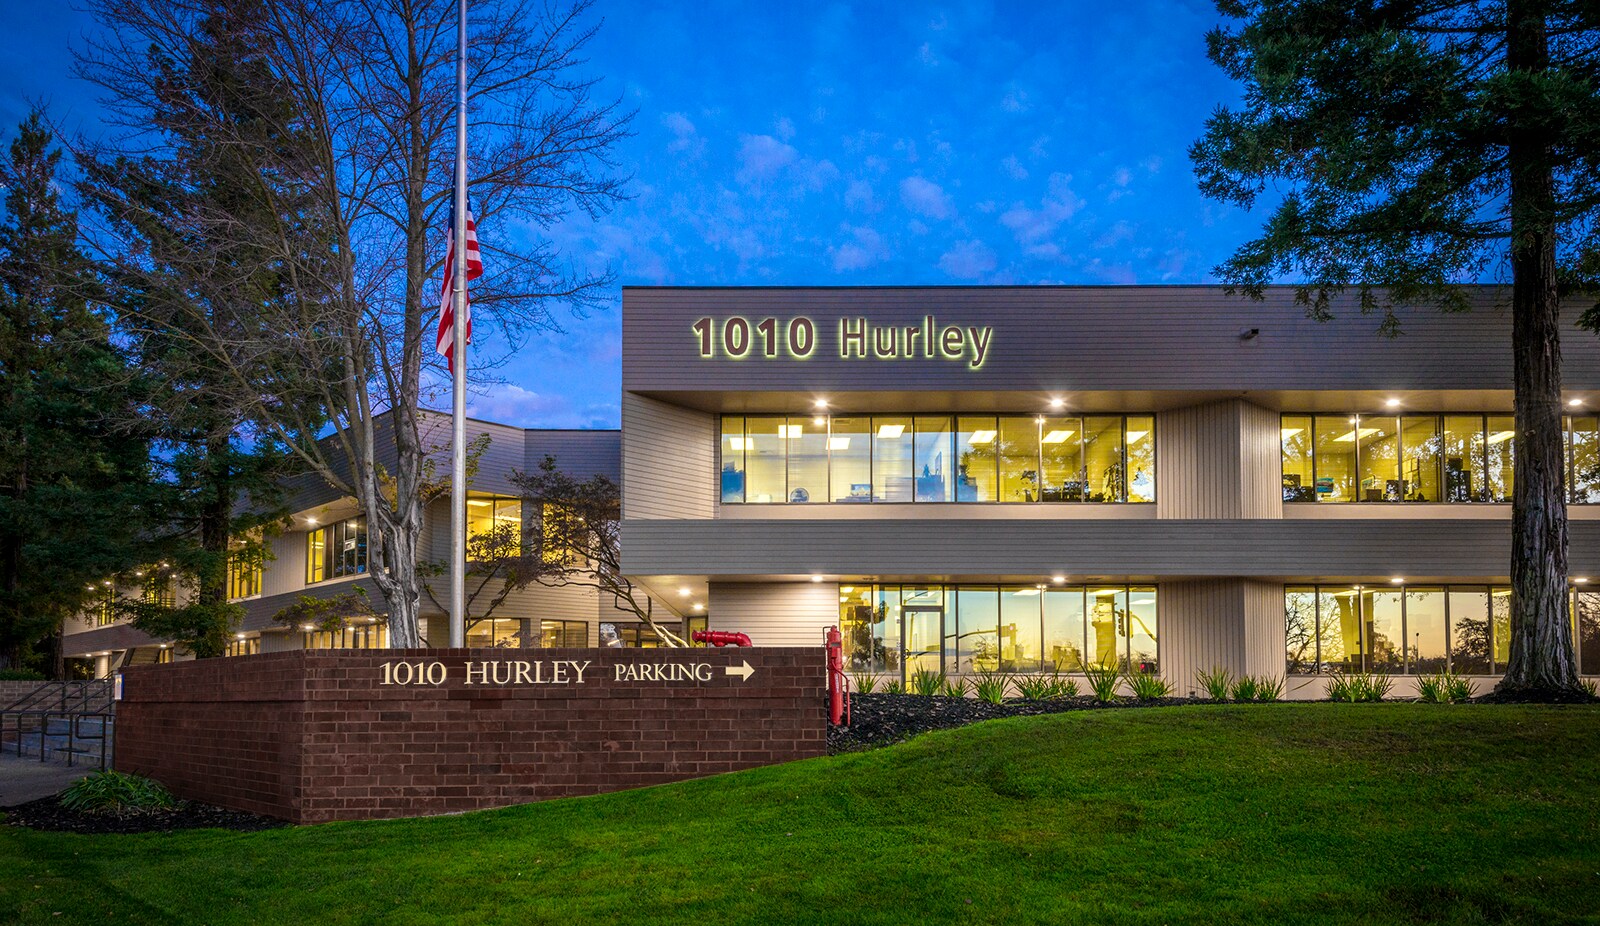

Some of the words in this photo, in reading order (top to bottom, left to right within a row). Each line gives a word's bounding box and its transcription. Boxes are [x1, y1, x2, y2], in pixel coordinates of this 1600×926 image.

[692, 317, 815, 357] 1010
[840, 315, 993, 368] Hurley
[379, 661, 447, 685] 1010
[464, 660, 592, 684] HURLEY
[614, 663, 713, 682] PARKING
